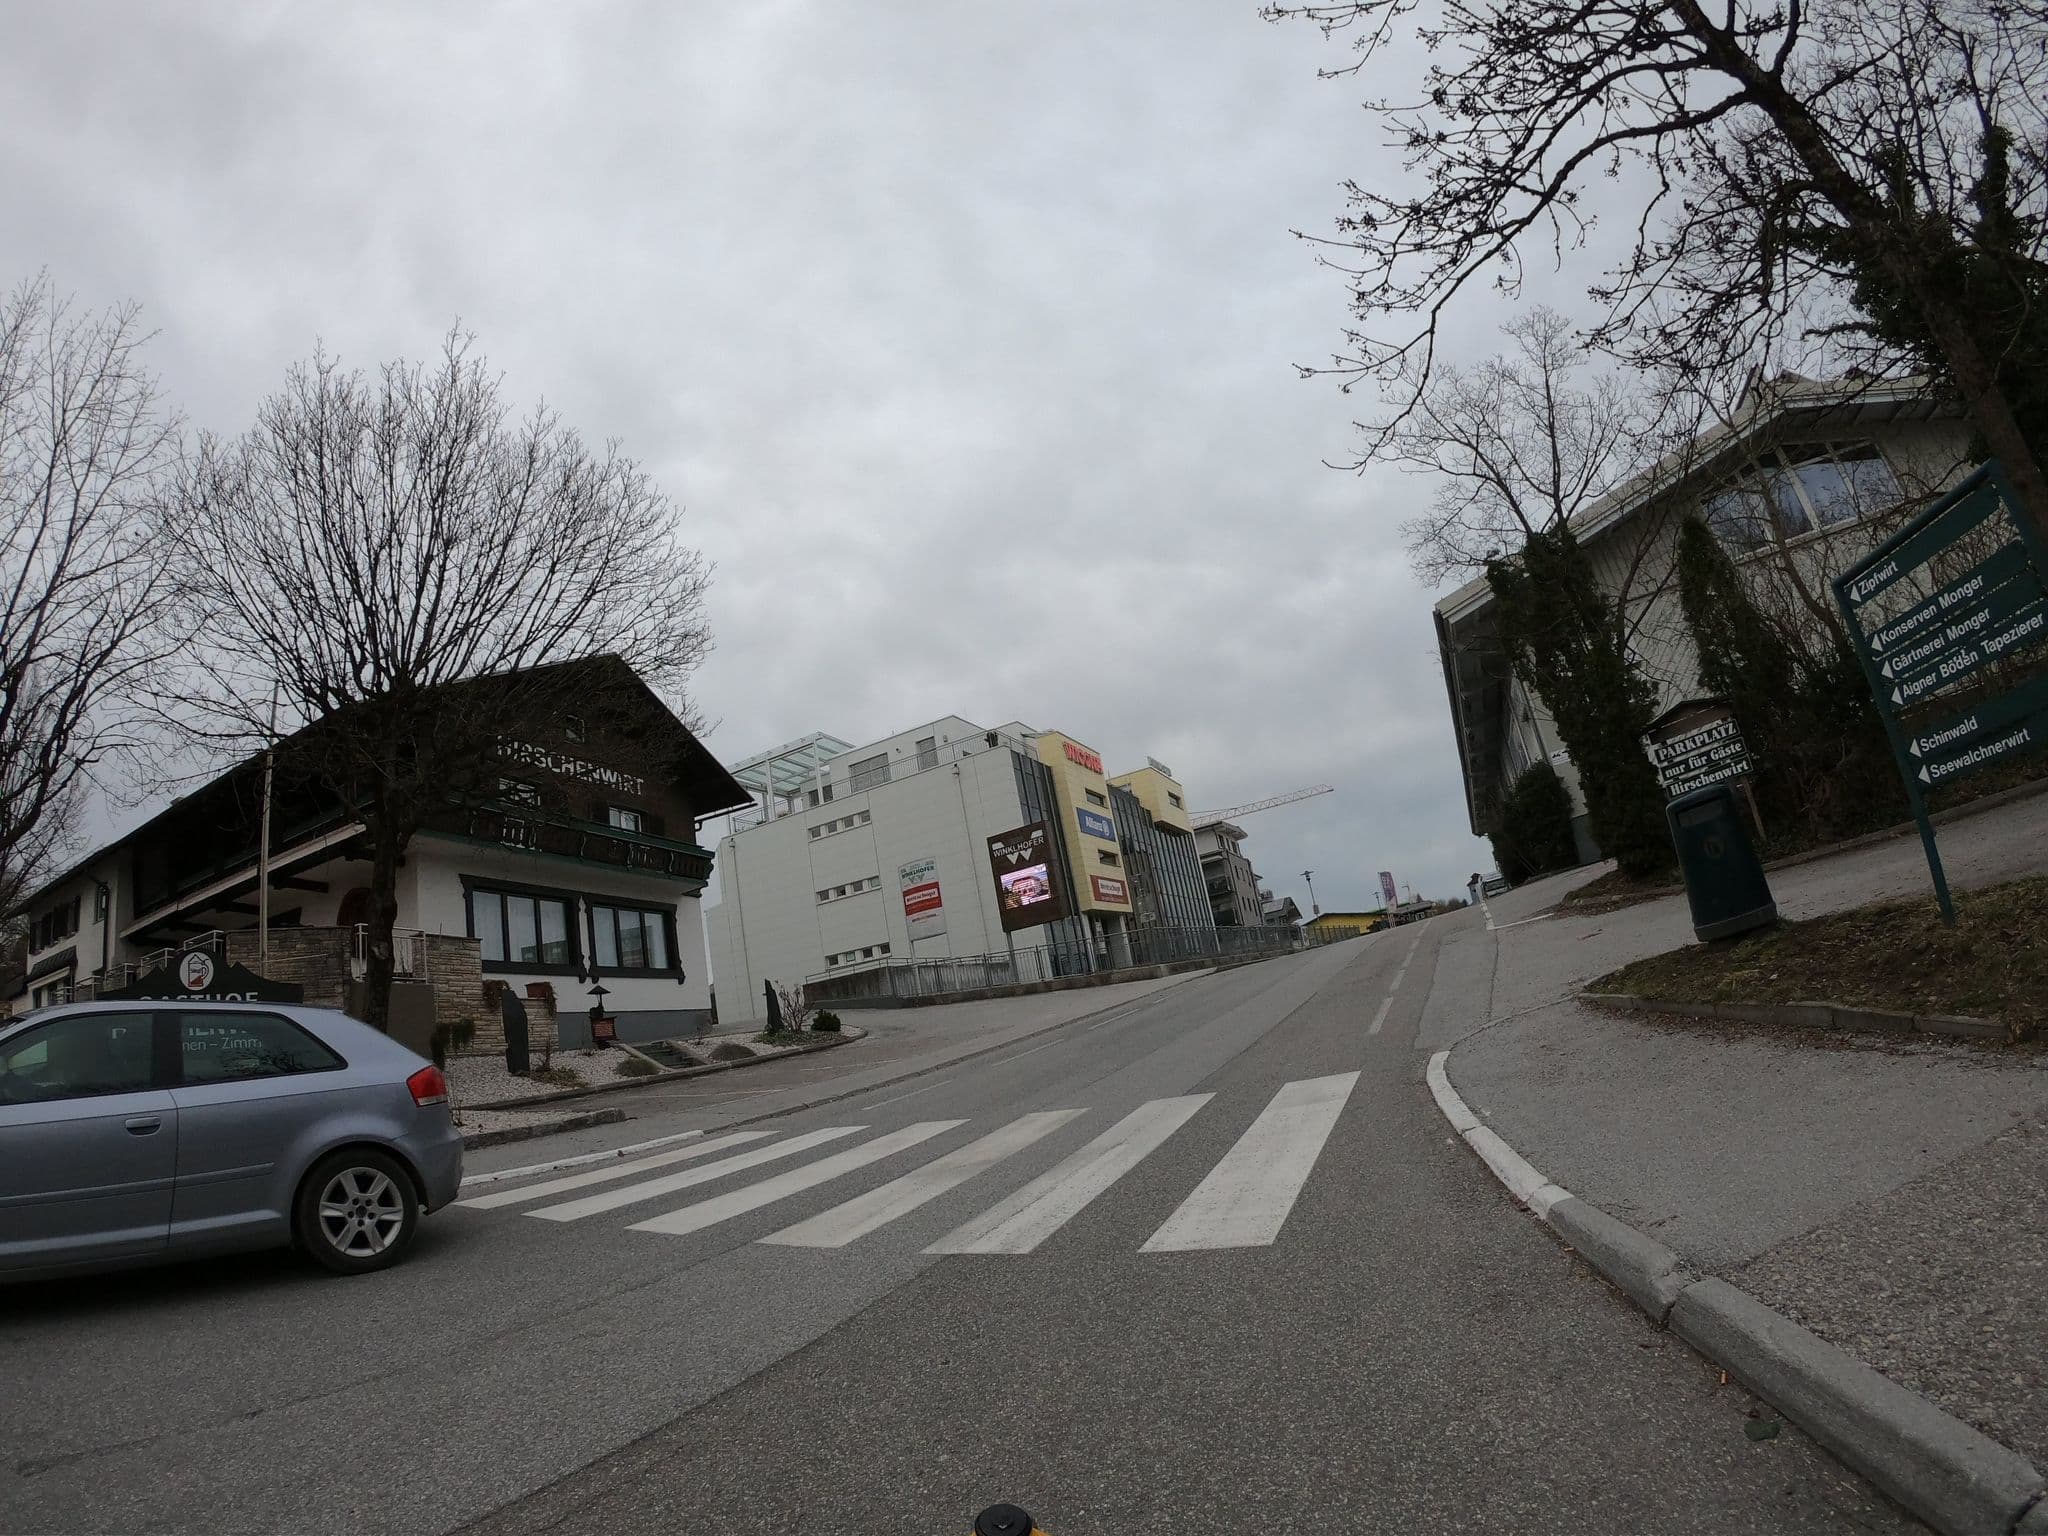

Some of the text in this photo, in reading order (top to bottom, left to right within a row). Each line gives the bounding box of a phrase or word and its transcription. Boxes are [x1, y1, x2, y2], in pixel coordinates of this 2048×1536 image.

[1858, 560, 1899, 597] Zipfwirt
[1880, 573, 1984, 645] Konserven Monger
[1891, 605, 1991, 672] Gärtnerei Monger
[1902, 611, 2046, 700] Aigner Böden Tapezierer
[1657, 722, 1737, 761] PARKPLATZ
[1919, 715, 1979, 753] Schinwald
[1665, 741, 1743, 778] nur für Gäste
[1930, 727, 2032, 780] Seewalchnerwirt
[1669, 759, 1749, 797] Hirschenwirt
[993, 836, 1045, 858] WINKLHOFER
